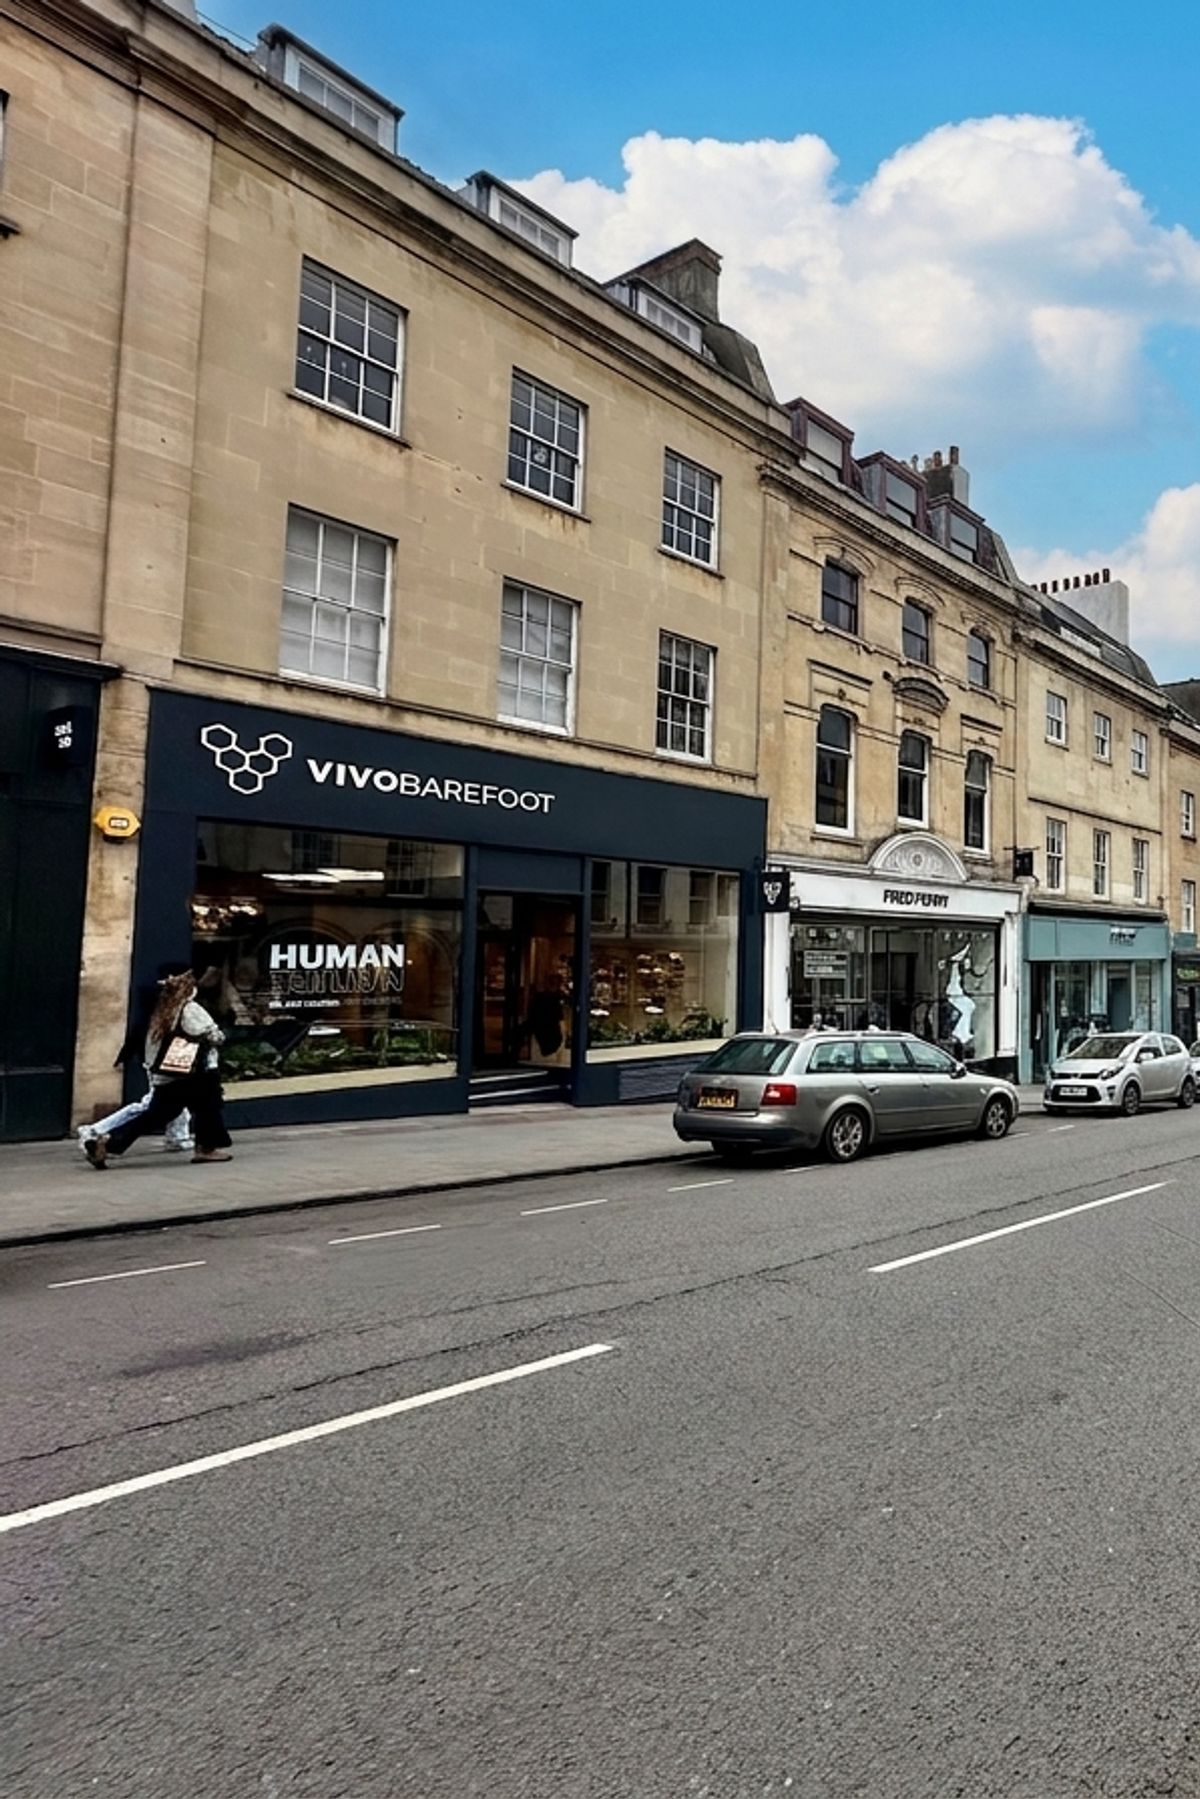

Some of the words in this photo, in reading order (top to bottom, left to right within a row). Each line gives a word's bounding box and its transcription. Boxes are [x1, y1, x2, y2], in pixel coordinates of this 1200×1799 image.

[306, 759, 555, 813] VIVOBAREFOOT
[883, 889, 914, 905] FRED
[270, 944, 405, 969] HUMAN
